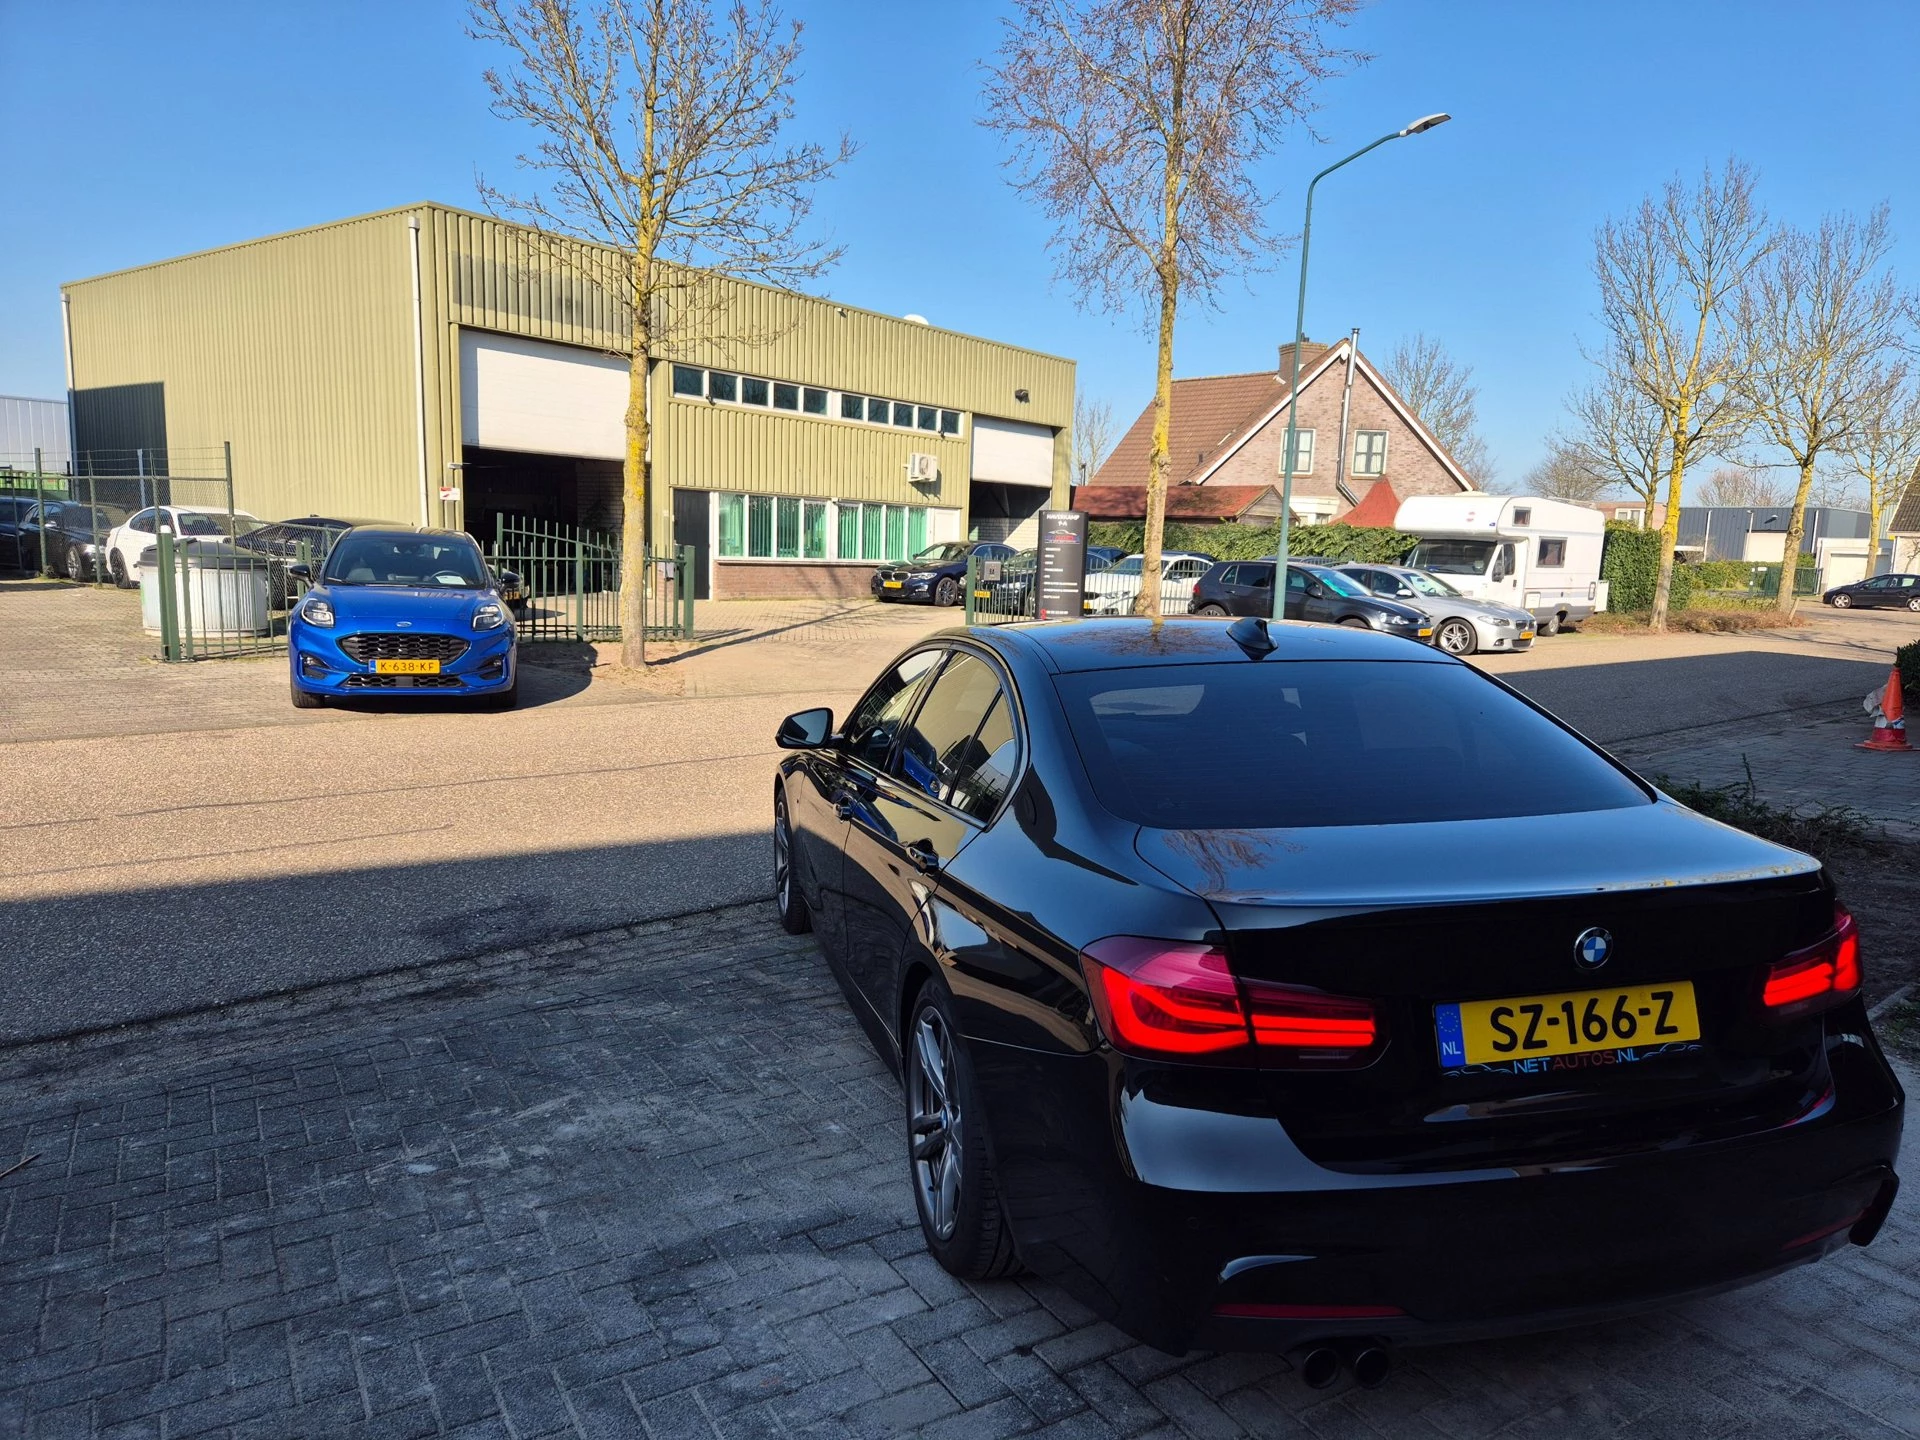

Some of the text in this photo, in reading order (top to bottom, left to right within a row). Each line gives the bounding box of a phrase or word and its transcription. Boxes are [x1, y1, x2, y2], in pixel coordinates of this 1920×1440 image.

[380, 662, 435, 672] K-638-KF
[1490, 991, 1679, 1053] SZ-166-Z
[1442, 1041, 1462, 1056] NL
